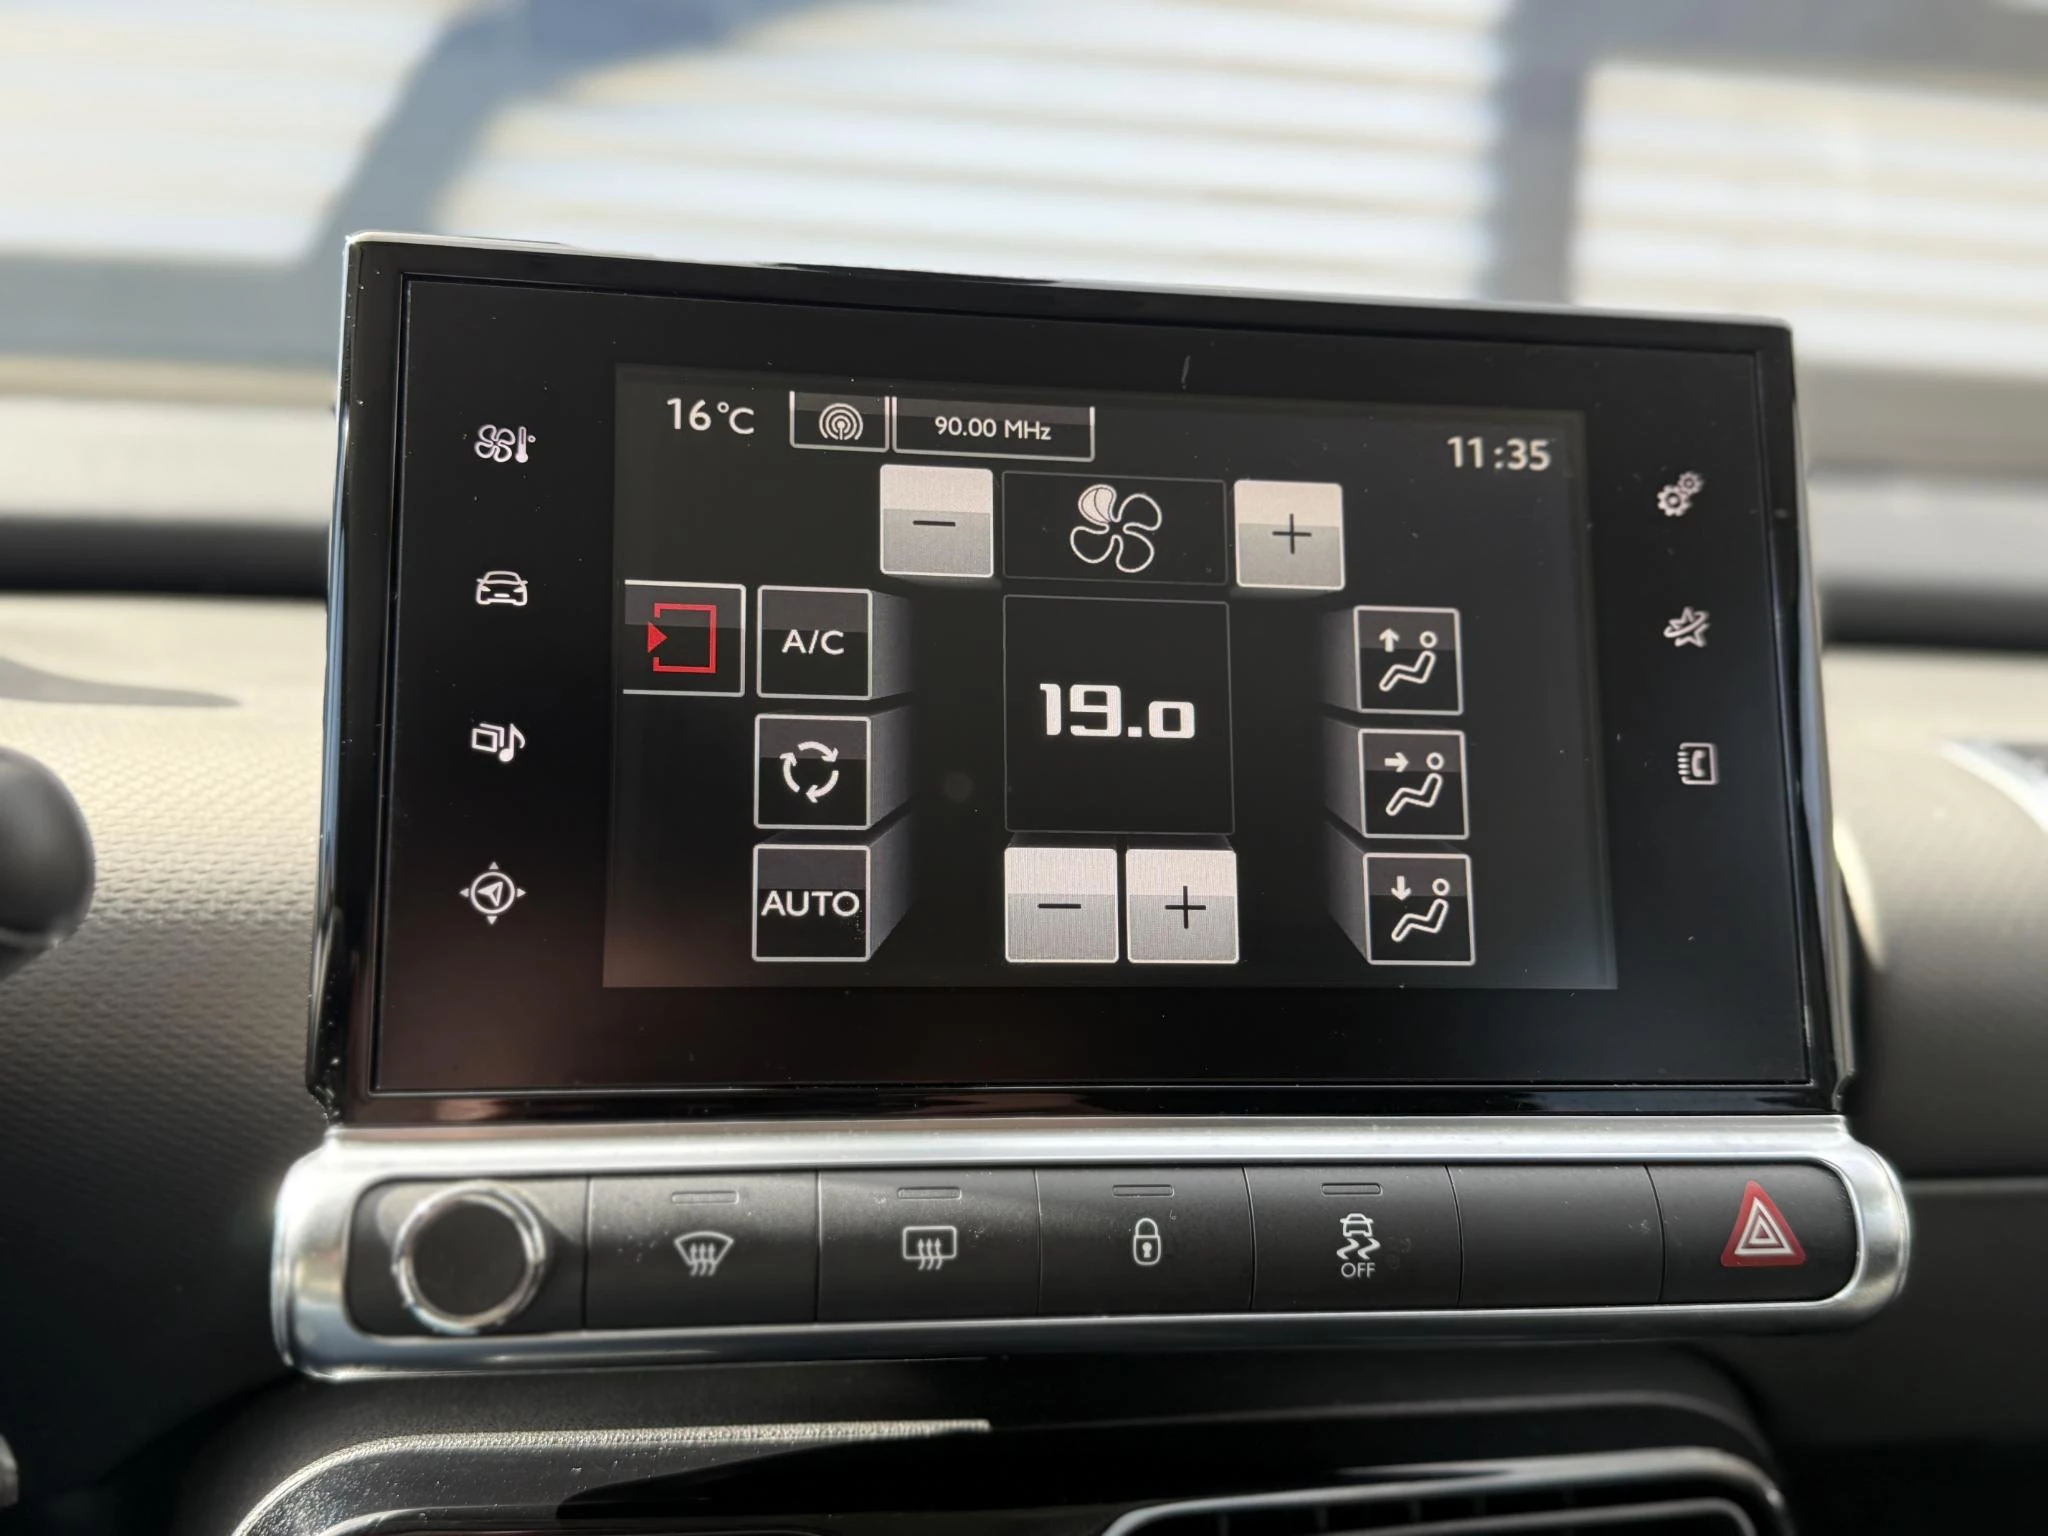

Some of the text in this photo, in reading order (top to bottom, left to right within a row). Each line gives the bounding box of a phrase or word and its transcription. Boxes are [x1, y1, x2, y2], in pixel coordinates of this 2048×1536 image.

[666, 397, 756, 435] 16°C
[934, 415, 1053, 441] 90.00 MHz
[1447, 435, 1552, 472] 11:35
[780, 628, 846, 656] A/C
[1039, 682, 1197, 740] 19.0
[760, 889, 861, 918] AUTO
[1340, 1262, 1376, 1279] OFF
